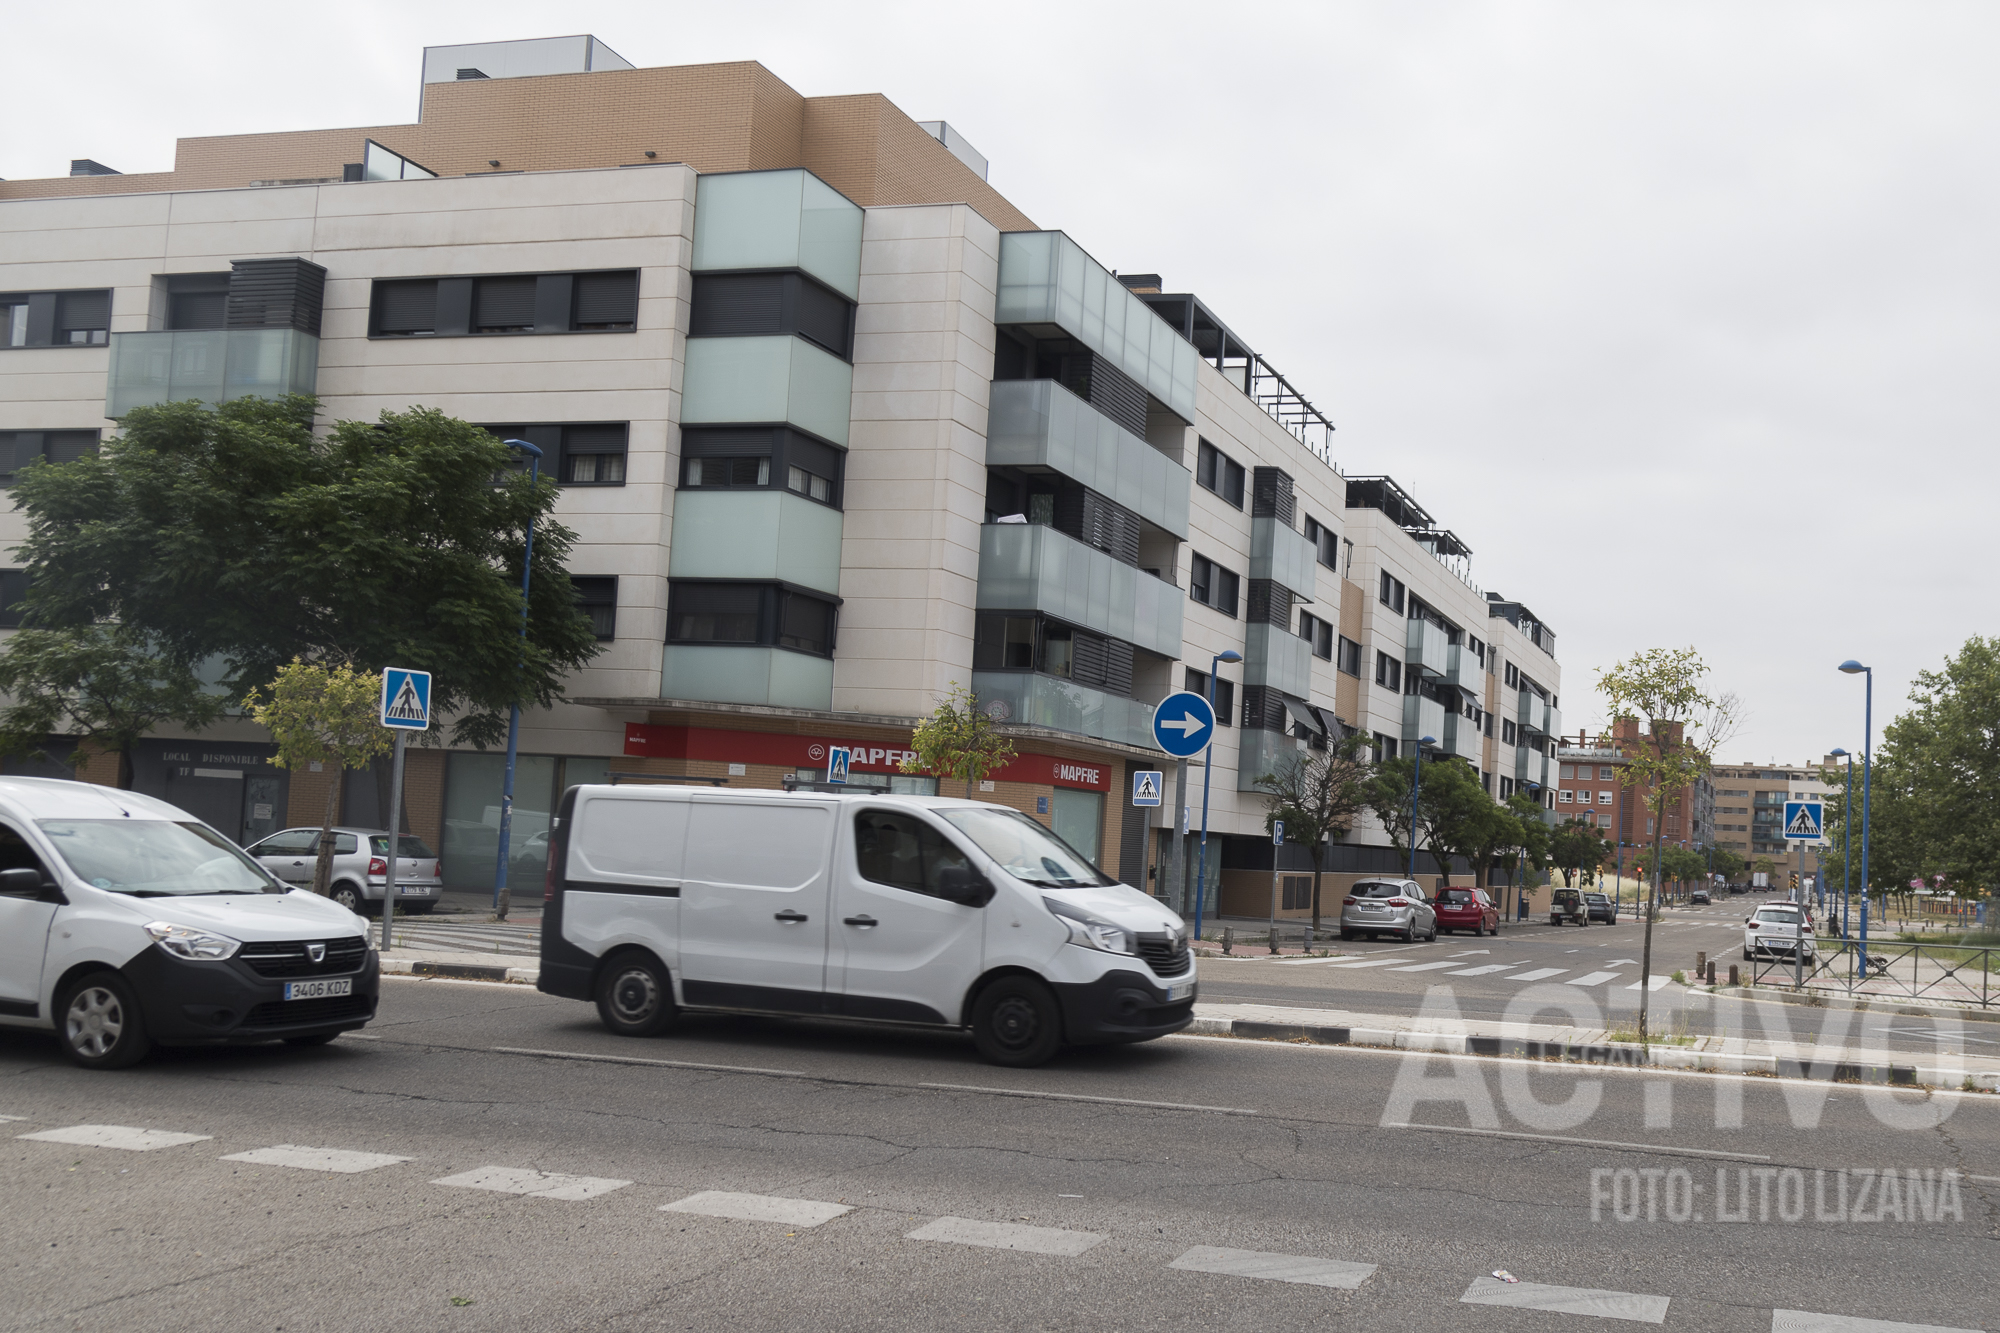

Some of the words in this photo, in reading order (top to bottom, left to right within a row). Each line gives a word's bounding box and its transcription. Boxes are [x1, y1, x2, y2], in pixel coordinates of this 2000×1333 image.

[163, 752, 191, 762] LOCAL
[202, 753, 259, 765] DISPONIBLE
[829, 745, 932, 769] APFR
[1060, 764, 1100, 784] MAPFRE
[1276, 823, 1283, 843] P
[293, 983, 324, 998] 3406
[326, 980, 349, 995] KDZ
